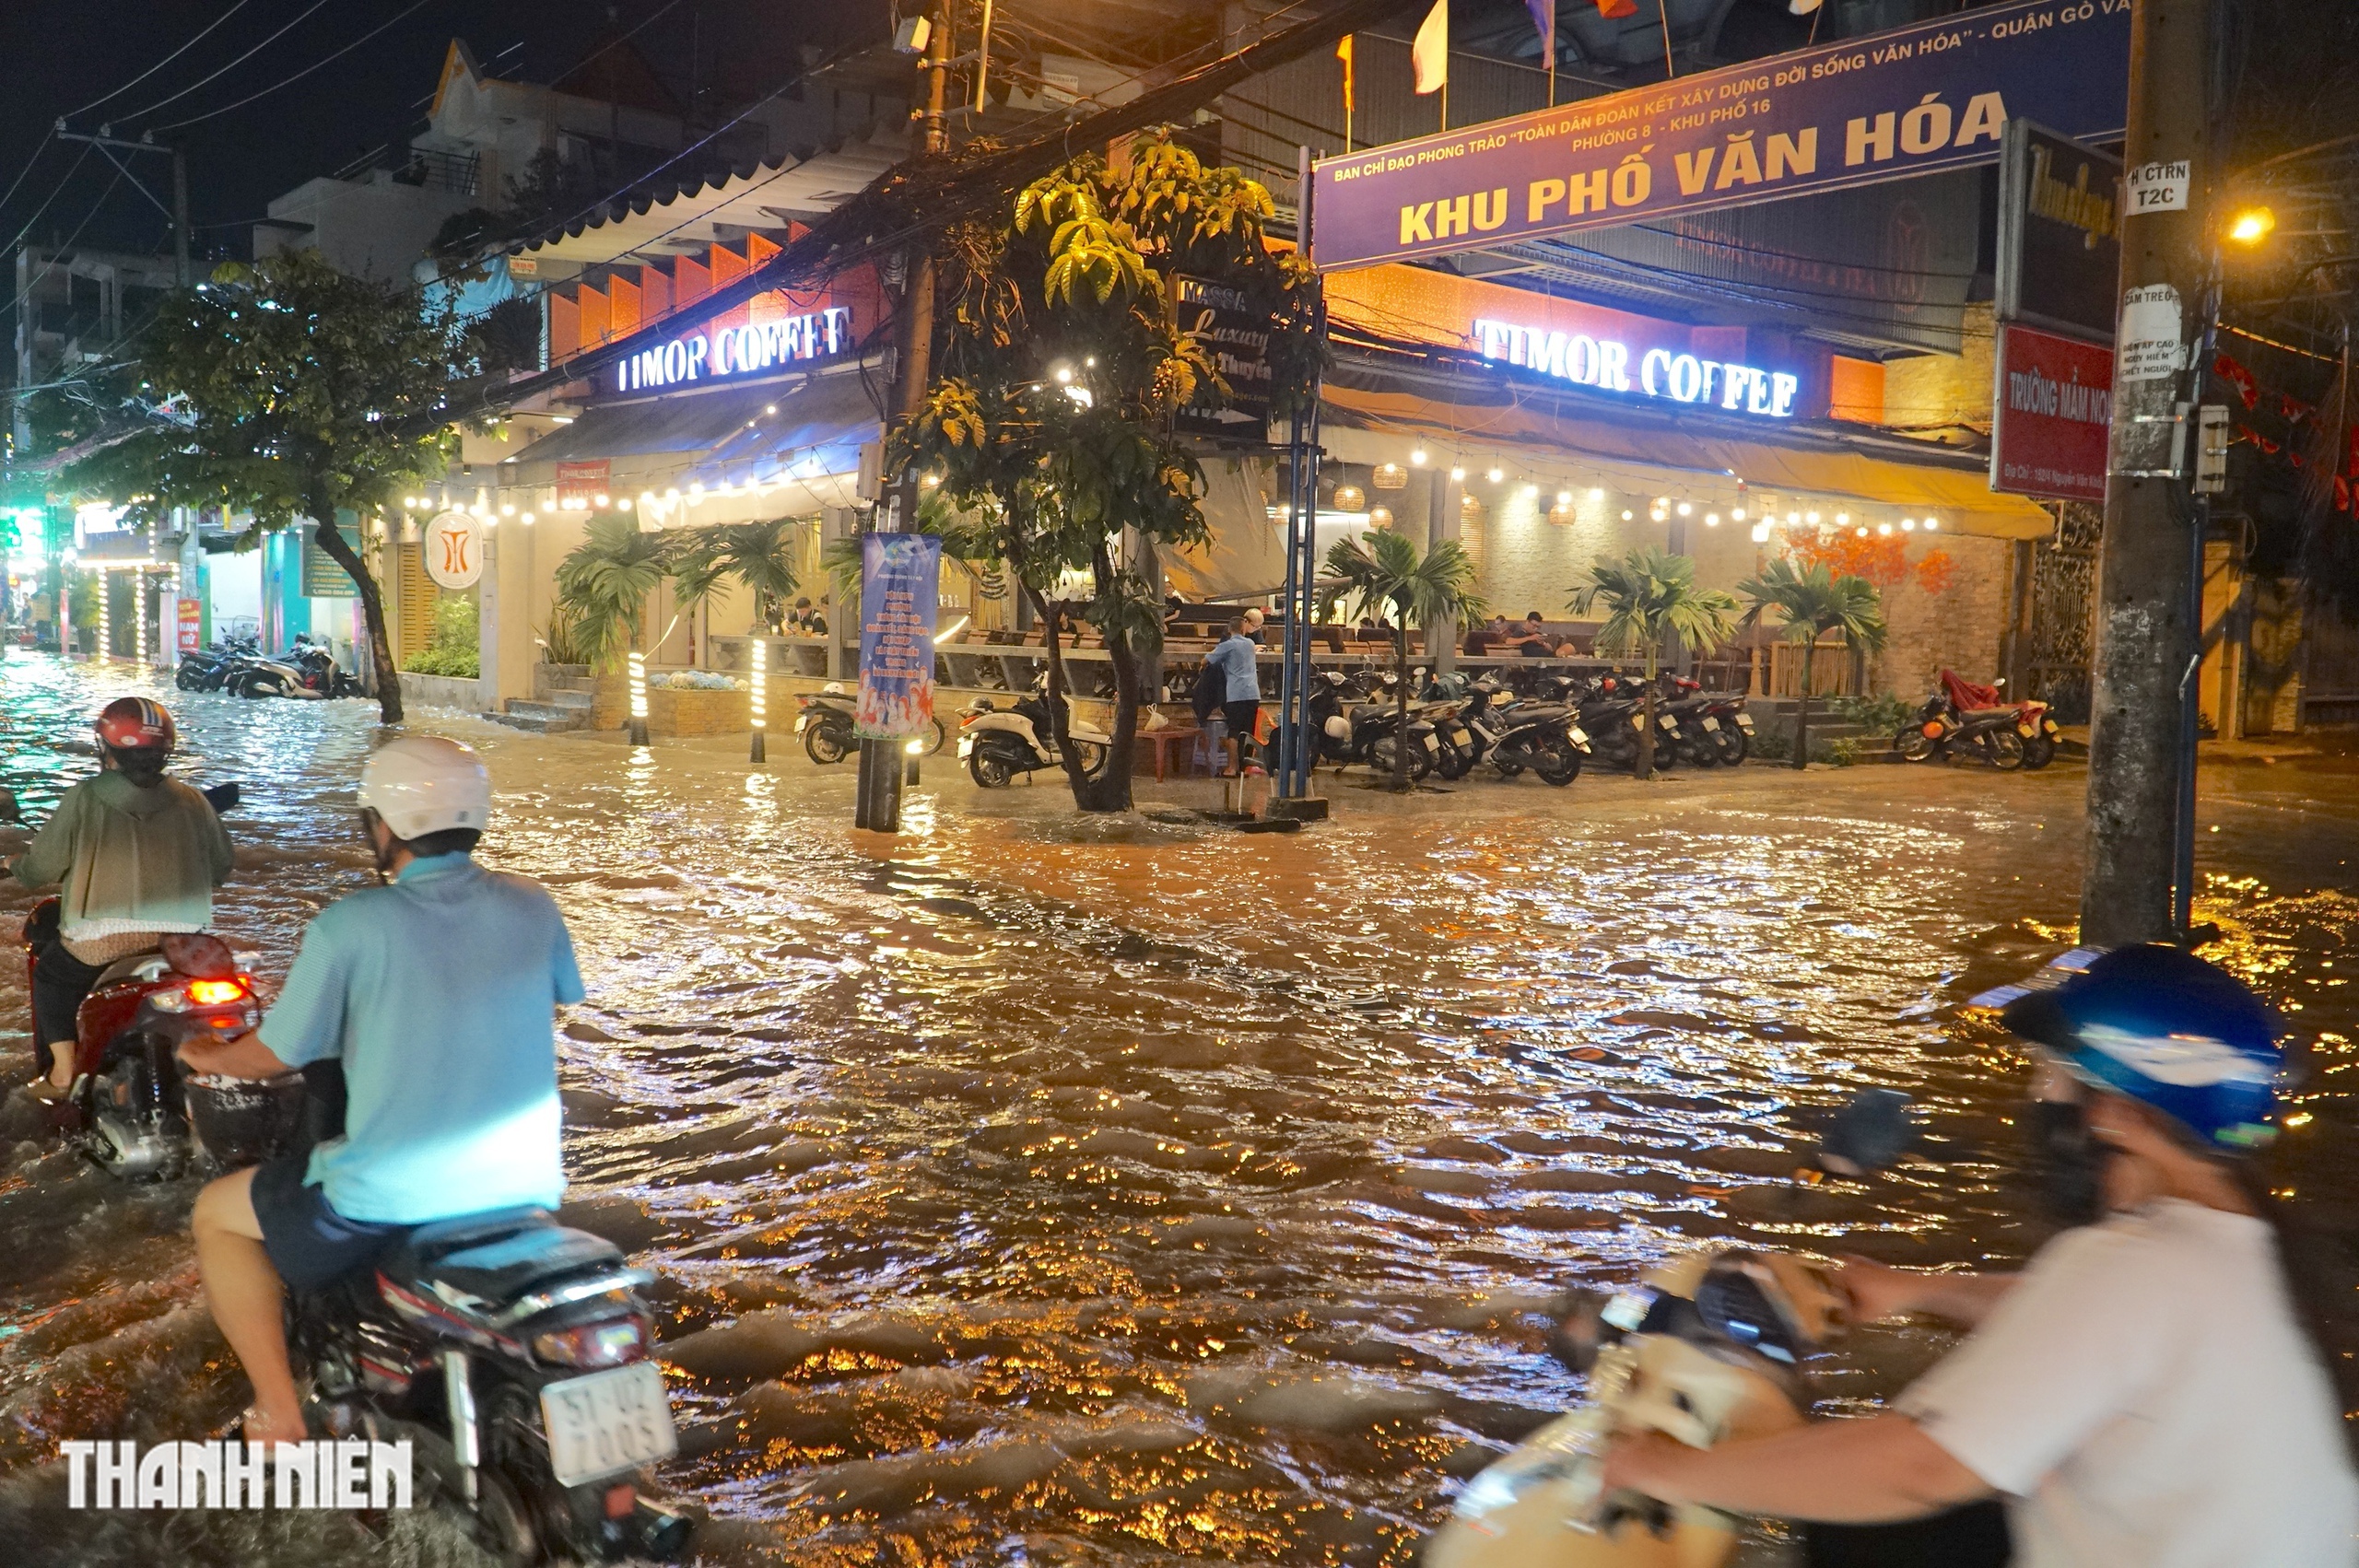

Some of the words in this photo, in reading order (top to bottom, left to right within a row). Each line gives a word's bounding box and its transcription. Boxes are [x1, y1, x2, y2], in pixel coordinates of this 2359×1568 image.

[1334, 167, 1360, 182] BAN
[1363, 156, 1385, 176] CHỈ
[1388, 154, 1414, 172] ĐẠO
[1417, 144, 1464, 165] PHONG
[1469, 135, 1507, 154] TRÀO
[1560, 113, 1591, 134] DÂN
[1596, 105, 1639, 126] ĐOÀN
[1645, 93, 1676, 115] KẾT
[1681, 85, 1715, 108] XÂY
[1719, 74, 1769, 99] DỰNG
[1775, 66, 1806, 88] ĐỜI
[1812, 53, 1866, 80] SỐNG
[1872, 43, 1912, 64] VĂN
[1991, 11, 2053, 39] QUẬN
[2060, 0, 2094, 24] GÒ
[1572, 125, 1637, 152] PHƯỜNG
[1642, 125, 1651, 138] 8
[1670, 112, 1705, 133] KHU
[1709, 99, 1747, 123] PHỐ
[1752, 99, 1771, 113] 16
[1399, 187, 1508, 245] KHU
[1528, 144, 1656, 223] PHỐ
[1672, 126, 1819, 197] VĂN
[1845, 91, 2009, 168] HÓA
[2145, 164, 2187, 181] CTRN
[2137, 188, 2175, 206] T2C
[1182, 309, 1269, 356] Luxury
[2156, 340, 2174, 348] CAO
[1474, 319, 1630, 392] TIMOR
[1640, 348, 1798, 418] COFFEE
[179, 622, 199, 632] NAM
